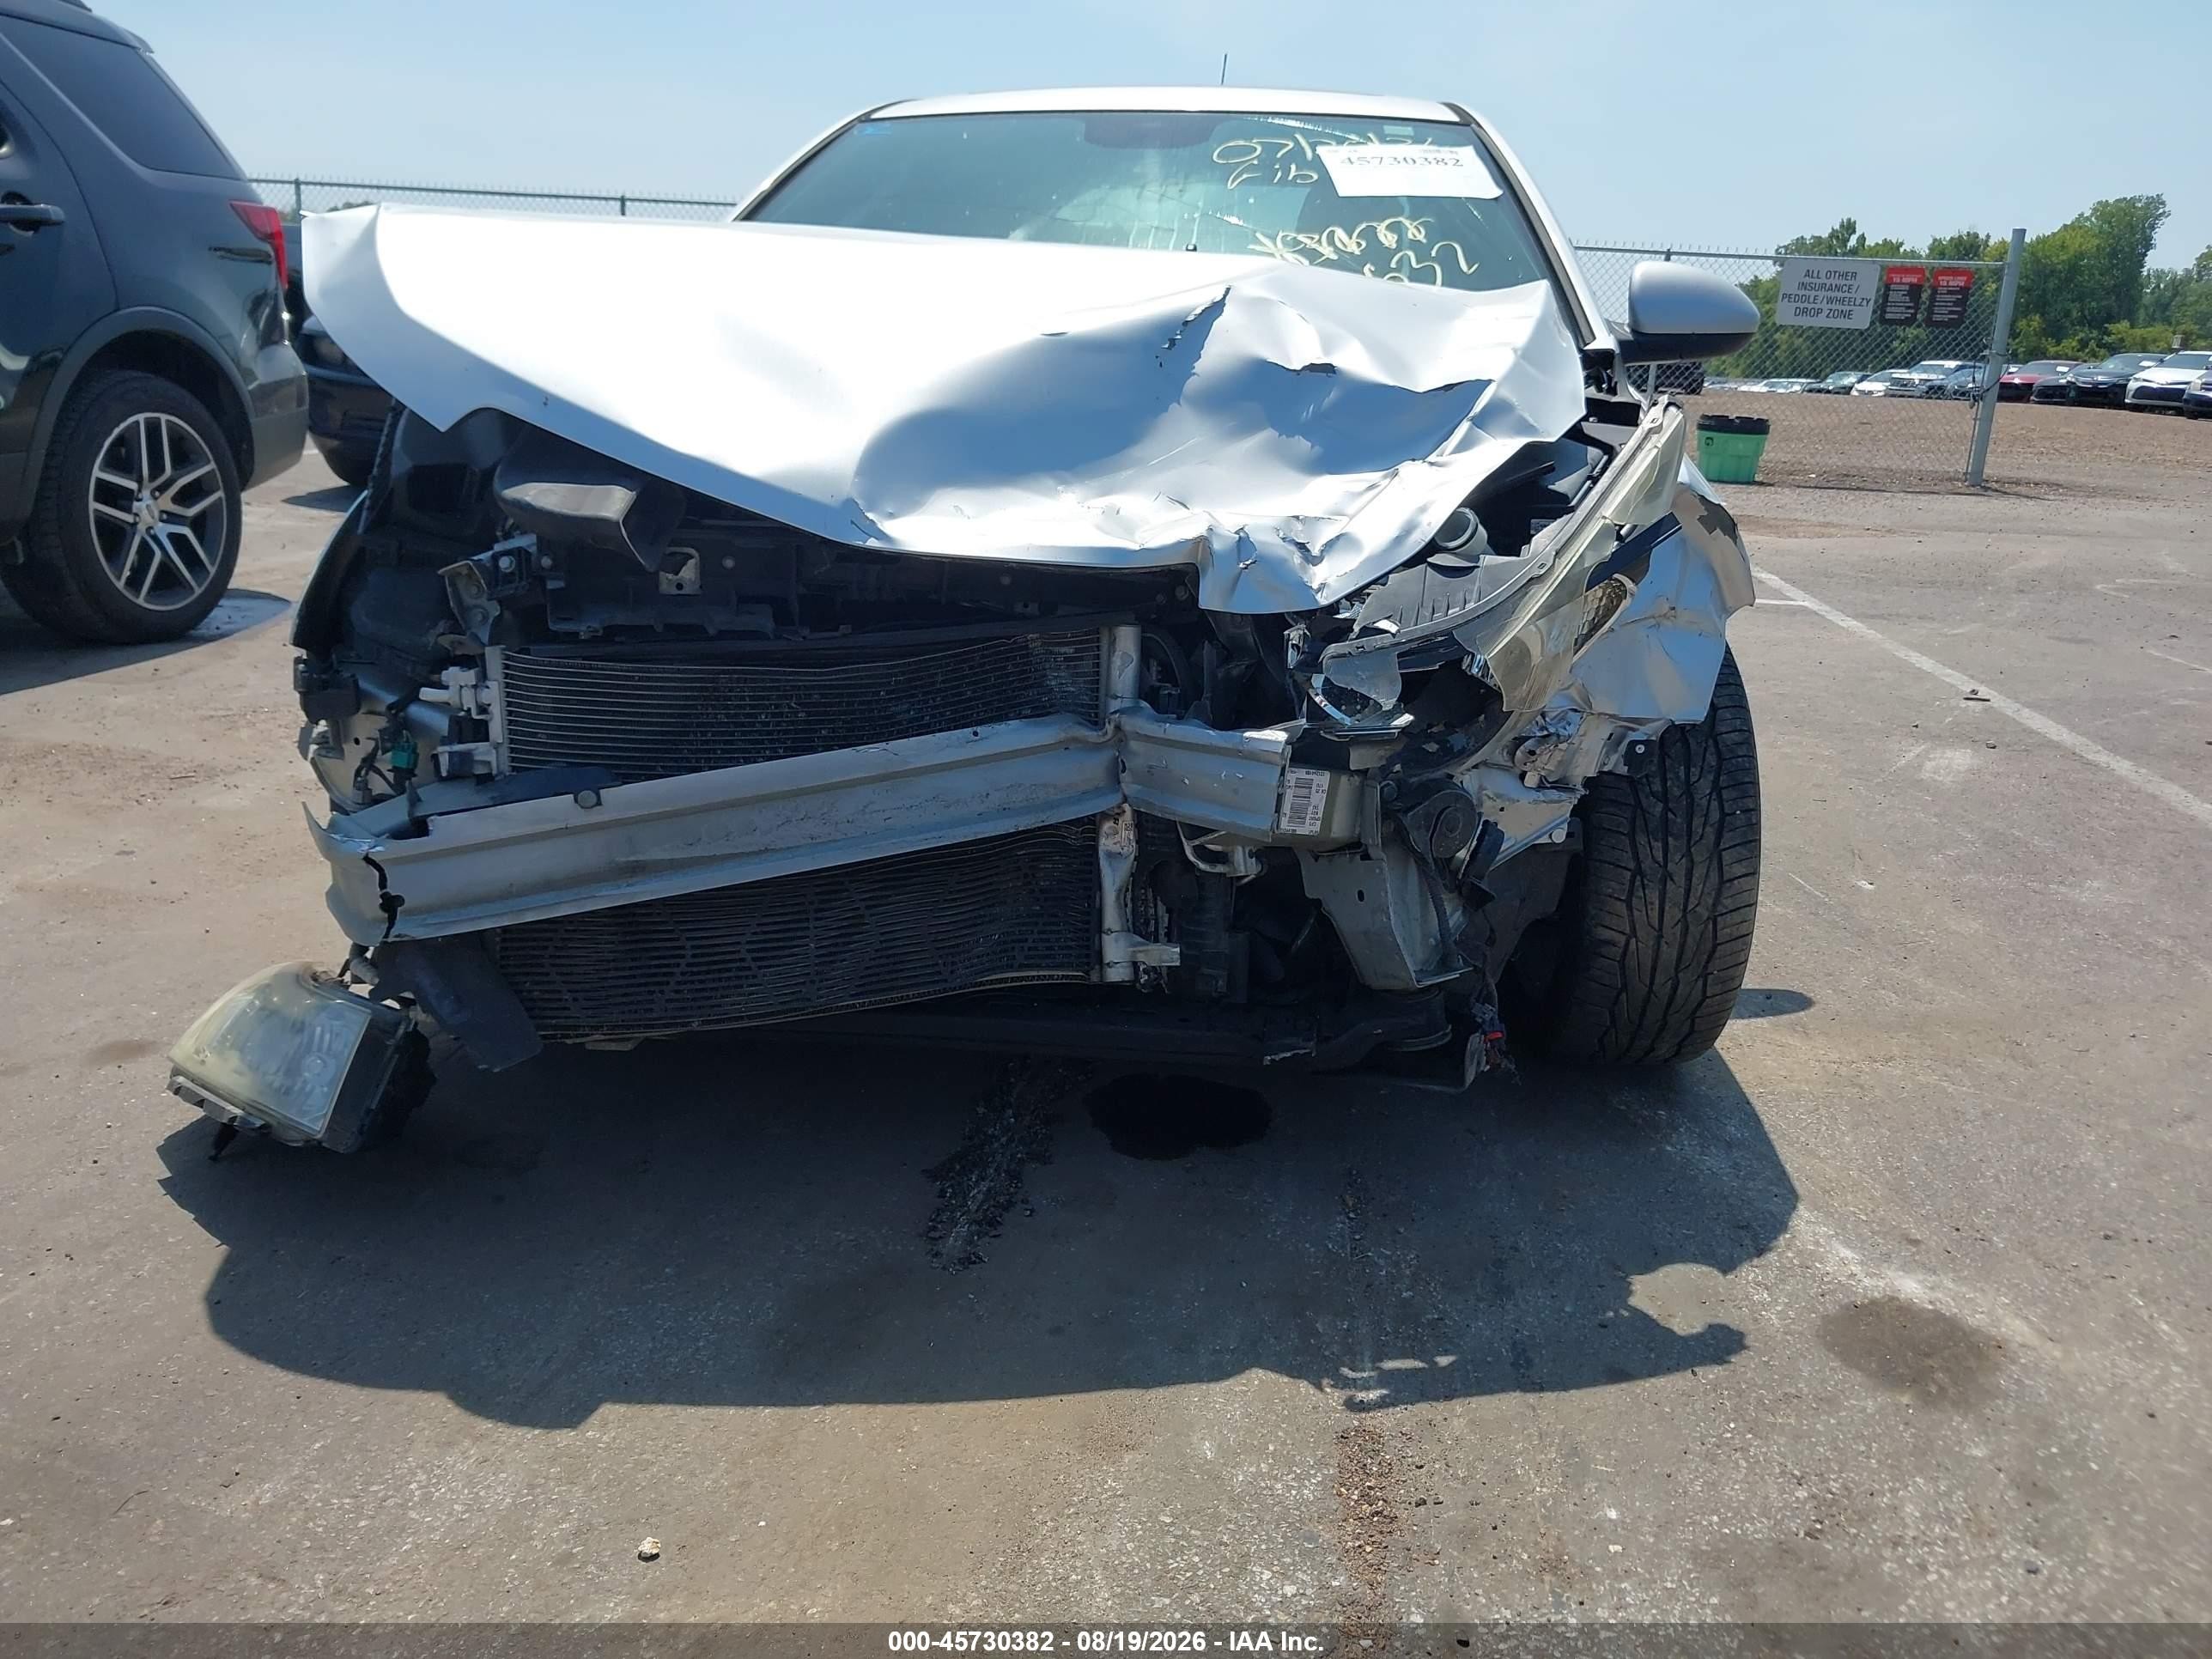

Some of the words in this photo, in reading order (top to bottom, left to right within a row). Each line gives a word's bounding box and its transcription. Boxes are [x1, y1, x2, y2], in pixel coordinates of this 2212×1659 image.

[1340, 156, 1464, 167] 45730382
[1803, 269, 1821, 280] ALL
[1826, 270, 1857, 281] OTHER
[1797, 282, 1854, 294] INSURANCE
[1826, 296, 1871, 307] WHEELZY
[1794, 307, 1823, 318] DROP
[1826, 308, 1854, 319] ZONE
